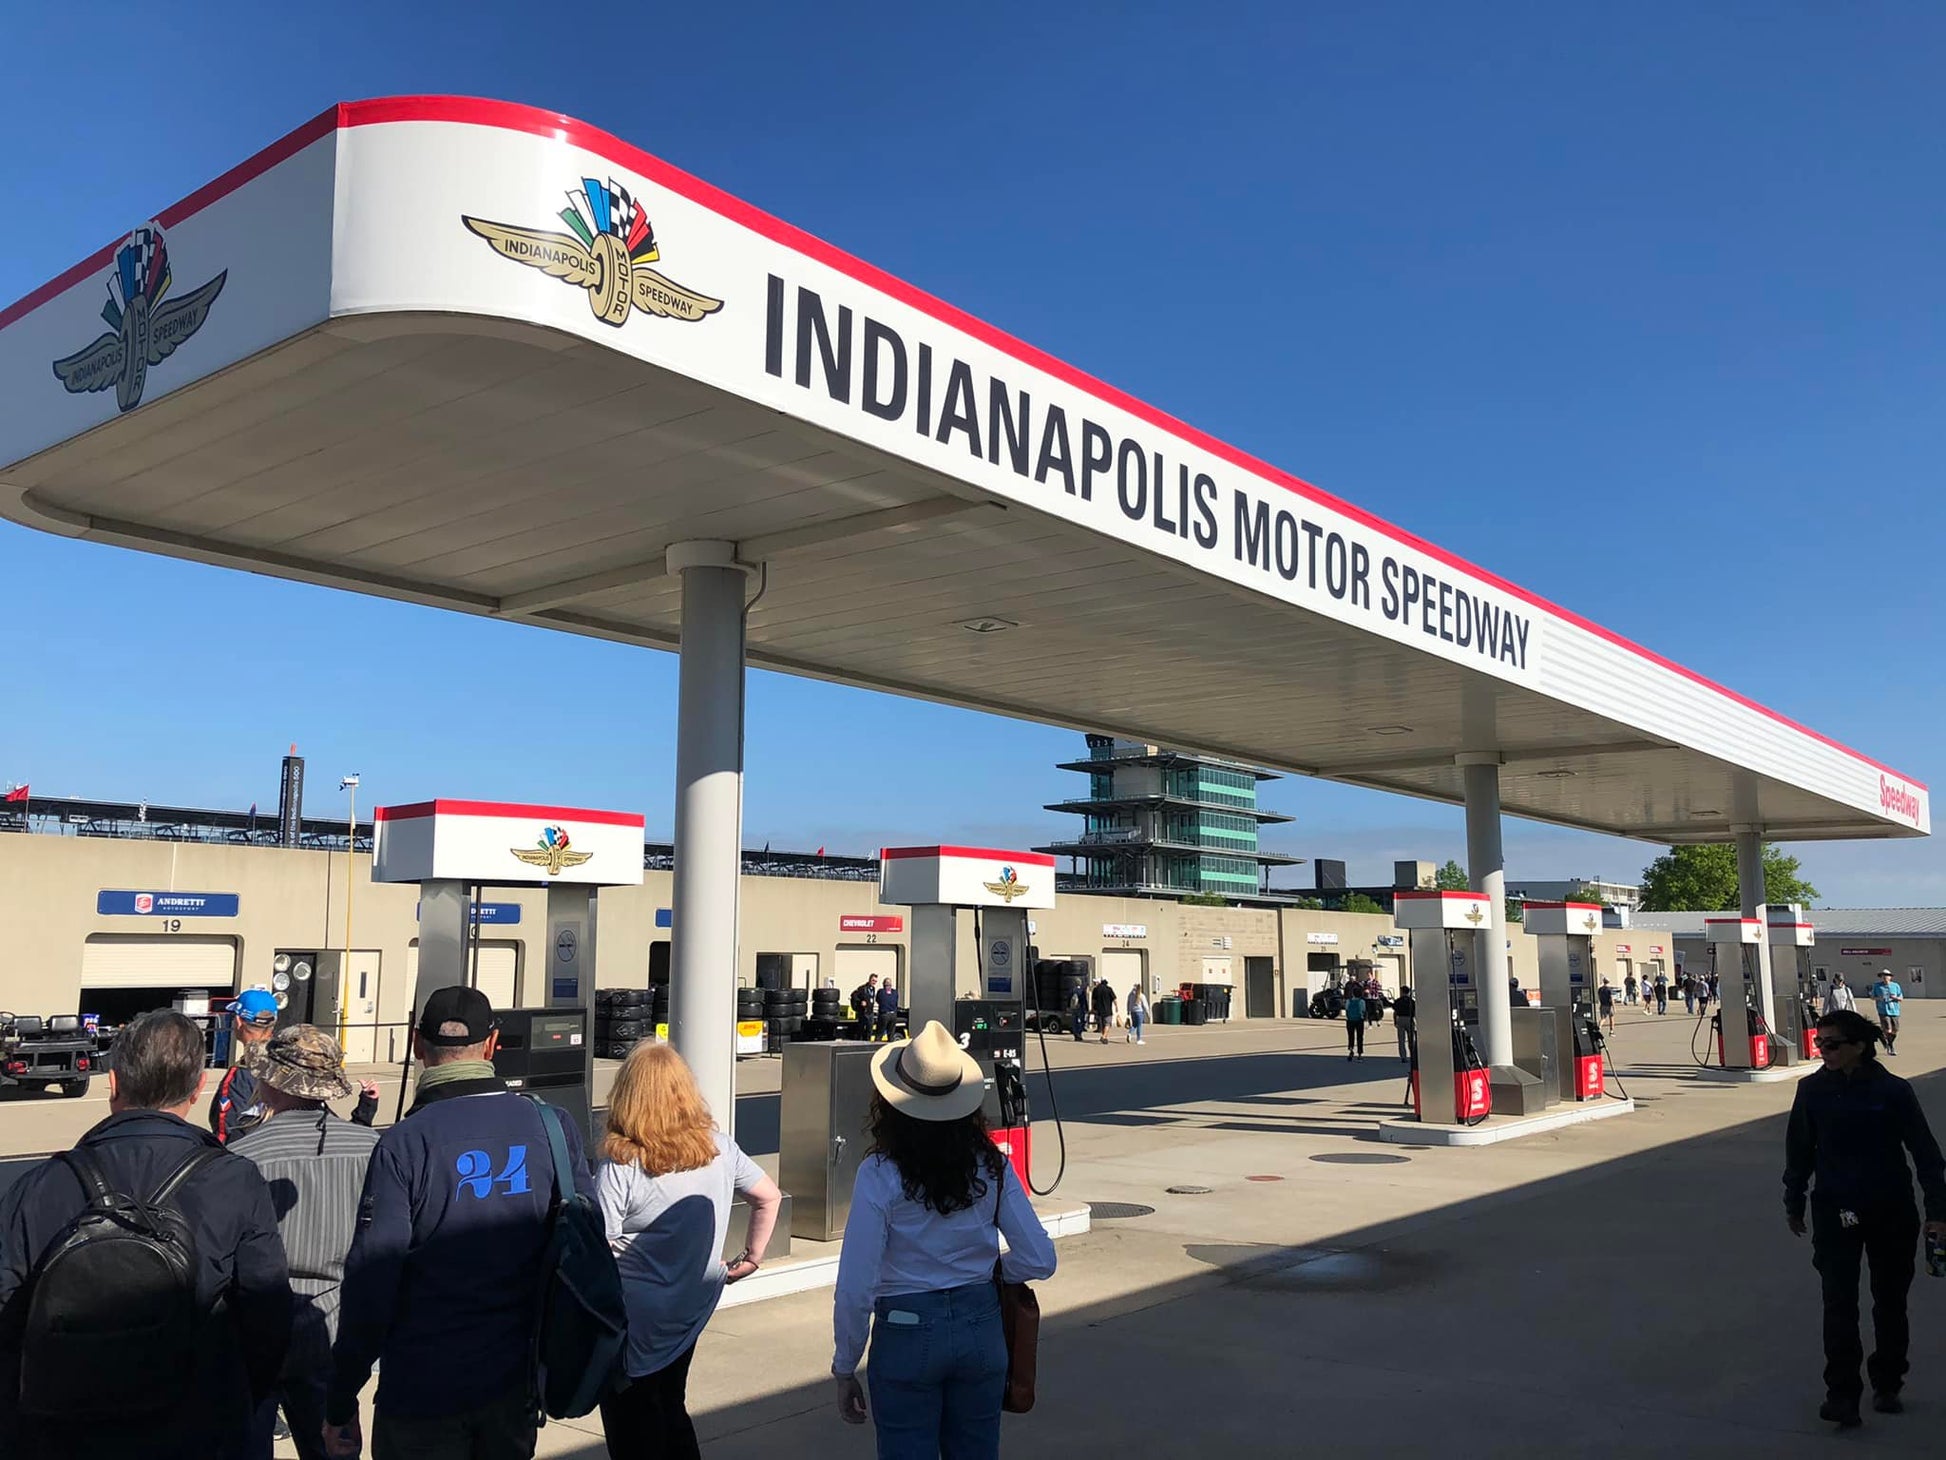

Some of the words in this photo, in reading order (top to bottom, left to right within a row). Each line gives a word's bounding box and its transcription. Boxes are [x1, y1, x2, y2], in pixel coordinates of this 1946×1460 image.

[504, 238, 597, 276] INDIANAPOLIS
[613, 247, 629, 318] MOTOR
[638, 283, 694, 316] SPEEDWAY
[153, 308, 199, 345] SPEEDWAY
[71, 350, 123, 385] INDIANAPOLIS
[133, 307, 146, 393] MOTOR
[765, 274, 1218, 549] INDIANAPOLIS
[1235, 490, 1370, 610] MOTOR
[1382, 557, 1530, 670] SPEEDWAY
[1880, 774, 1920, 826] Speedway
[157, 898, 206, 907] ANDRETTI
[162, 919, 181, 932] 19
[866, 933, 877, 943] 22
[959, 1032, 971, 1050] 3
[456, 1145, 532, 1202] 24
